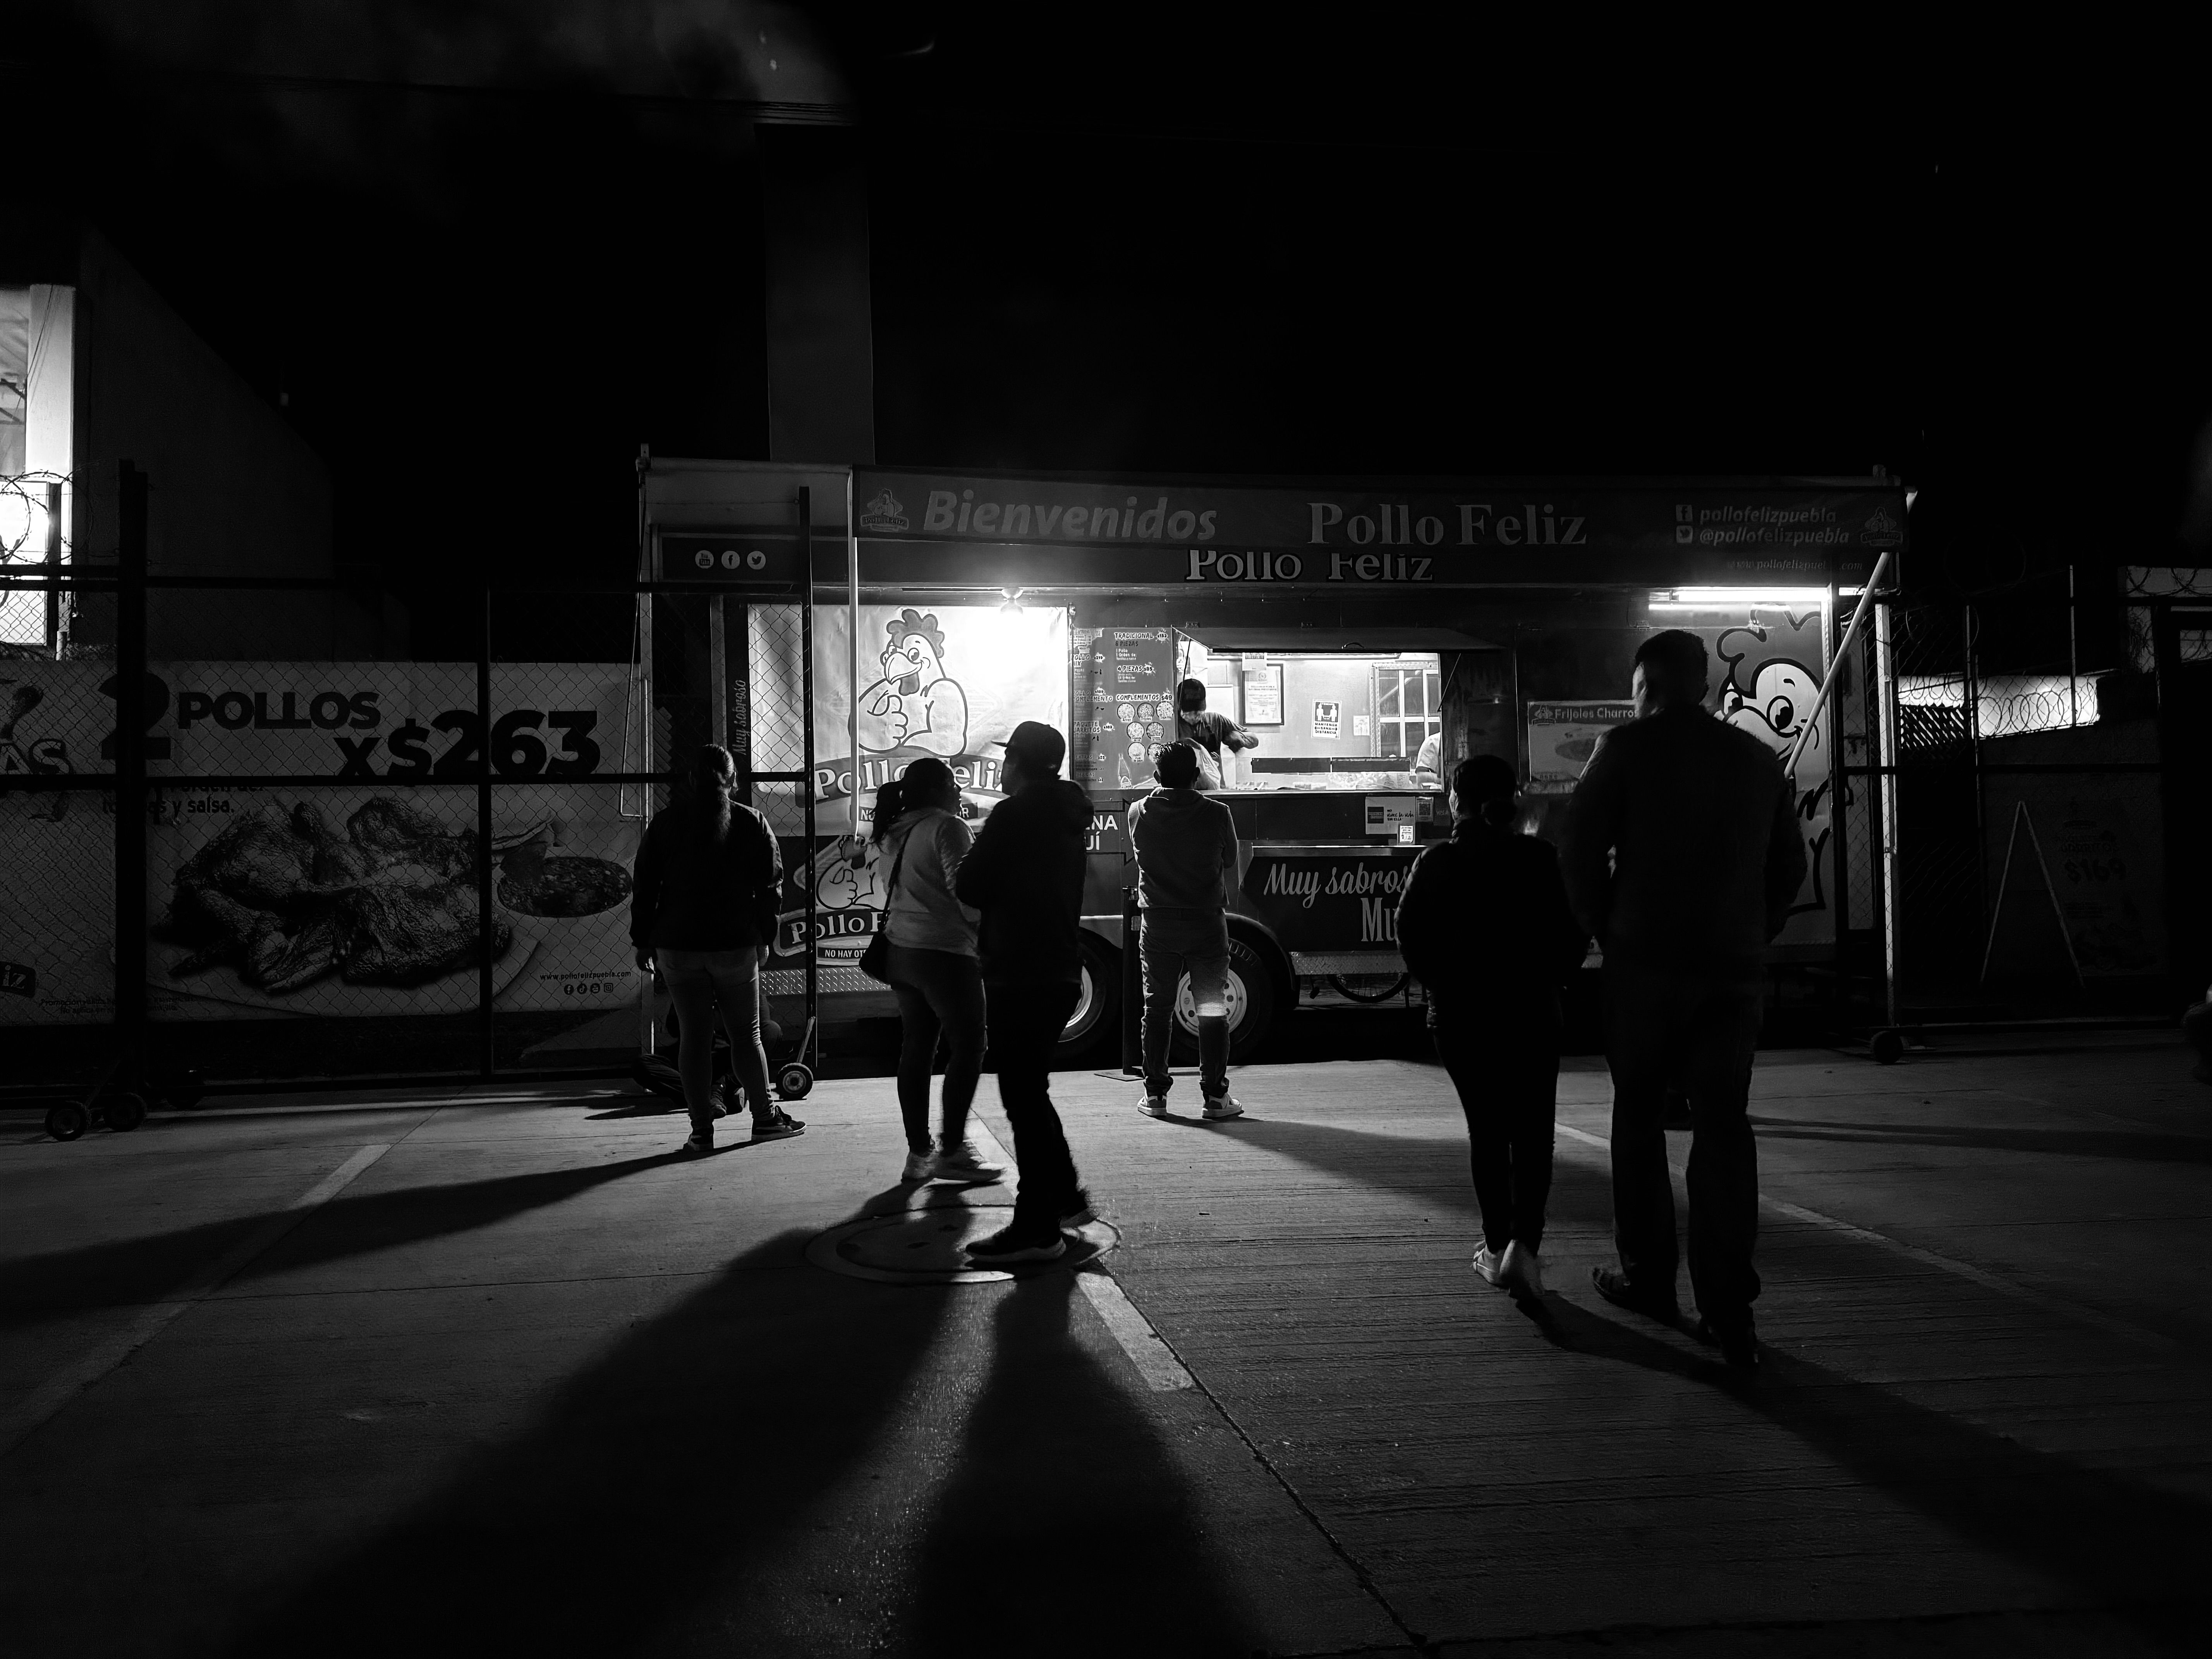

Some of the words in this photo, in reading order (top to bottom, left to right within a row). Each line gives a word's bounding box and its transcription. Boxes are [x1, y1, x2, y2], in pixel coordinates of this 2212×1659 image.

[924, 489, 1218, 540] Bienvenidos
[1307, 503, 1444, 546] Pollo
[1456, 503, 1587, 546] Feliz
[1700, 506, 1837, 527] pollofelizpuebla
[1700, 527, 1850, 546] @pollofelizpuebla
[1186, 549, 1302, 580] Pollo
[1328, 553, 1432, 581] Feliz
[1728, 559, 1863, 571] www.pollofelizpue.com
[98, 671, 170, 760] 2
[178, 691, 381, 730] POLLOS
[1555, 708, 1594, 721] Frijoles
[732, 728, 750, 755] Muy
[187, 794, 234, 813] salsa.
[1085, 815, 1118, 830] NA
[2064, 858, 2127, 884] $169
[1263, 863, 1321, 909] Muy
[1325, 862, 1408, 895] sabros
[787, 914, 865, 944] Pollo
[1360, 897, 1398, 942] Mu
[825, 950, 836, 958] NO
[838, 950, 853, 958] HAY
[539, 971, 632, 980] www.pollofelizpuebla.com
